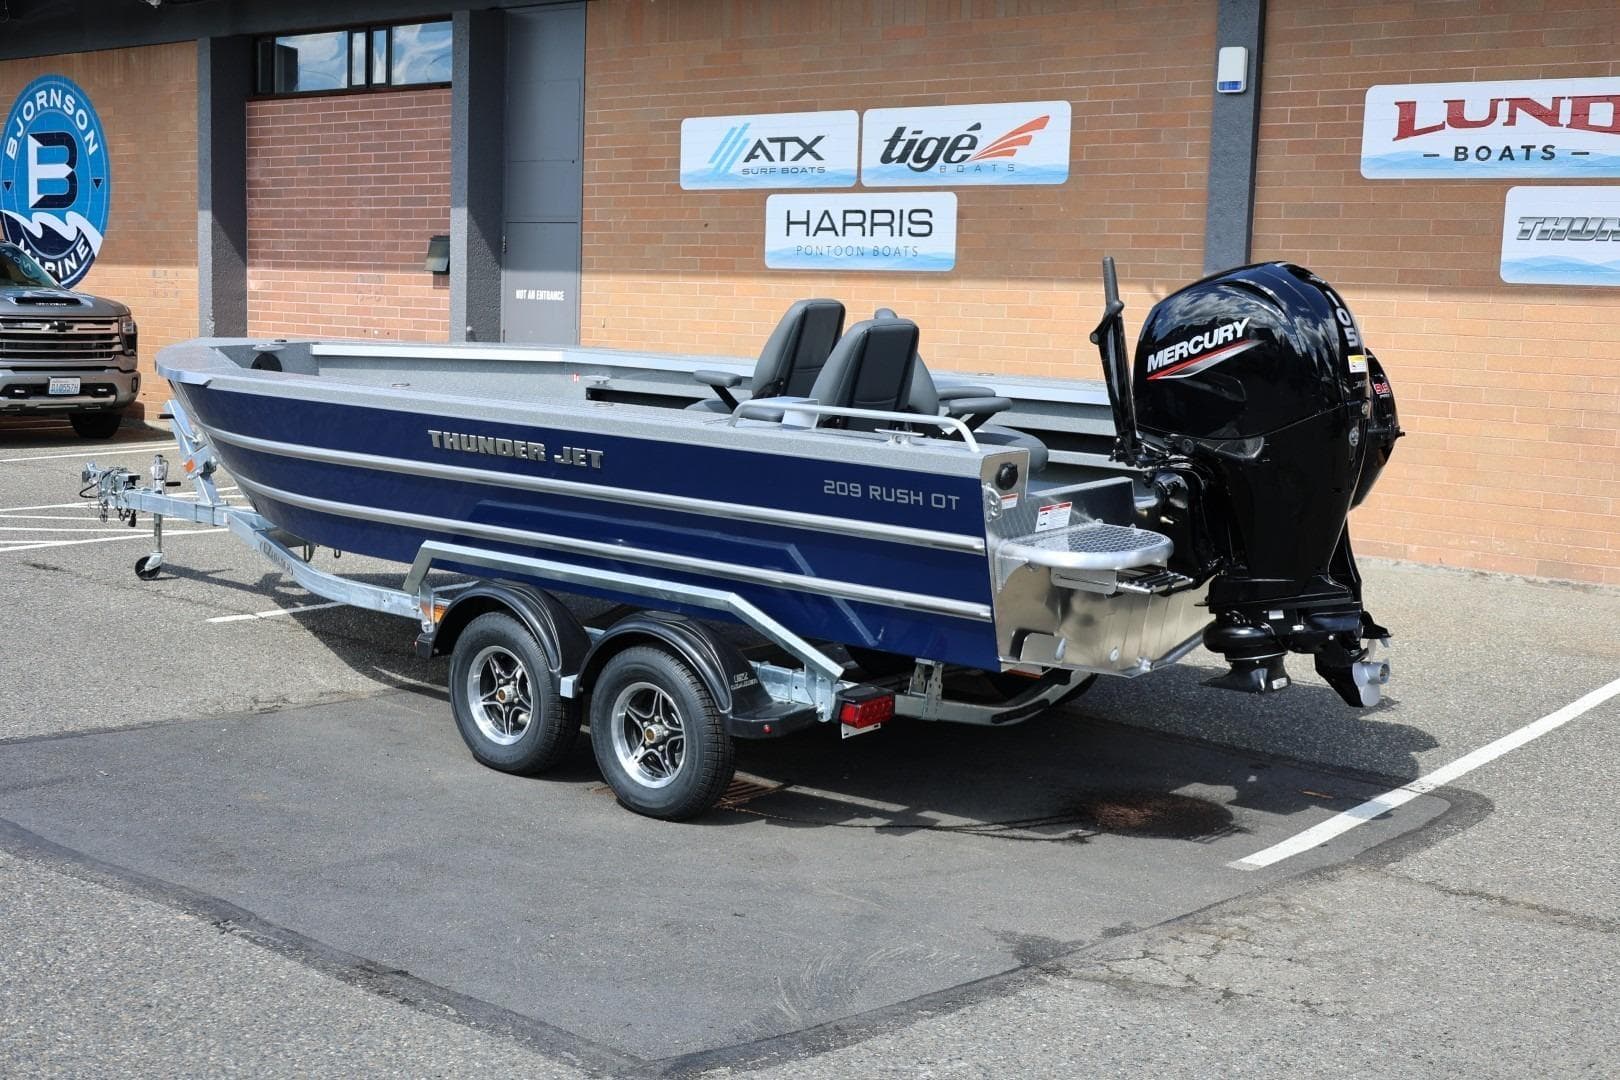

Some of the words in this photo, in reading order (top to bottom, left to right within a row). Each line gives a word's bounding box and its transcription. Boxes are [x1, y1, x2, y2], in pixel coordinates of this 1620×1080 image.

[6, 89, 98, 159] BJORNSON
[1392, 95, 1620, 141] LUND
[742, 135, 826, 163] ATX
[1454, 144, 1556, 162] BOATS
[781, 166, 826, 174] BOATS
[939, 163, 1015, 174] BOATS
[786, 208, 934, 238] HARRIS
[796, 245, 865, 257] PONTOON
[872, 246, 919, 257] BOATS
[515, 289, 527, 300] NOT
[536, 290, 565, 301] ENTRANCE
[1147, 317, 1250, 373] MERCURY
[428, 429, 546, 462] THUNDER
[553, 446, 604, 469] JET
[824, 480, 861, 497] 209
[869, 485, 922, 506] RUSH
